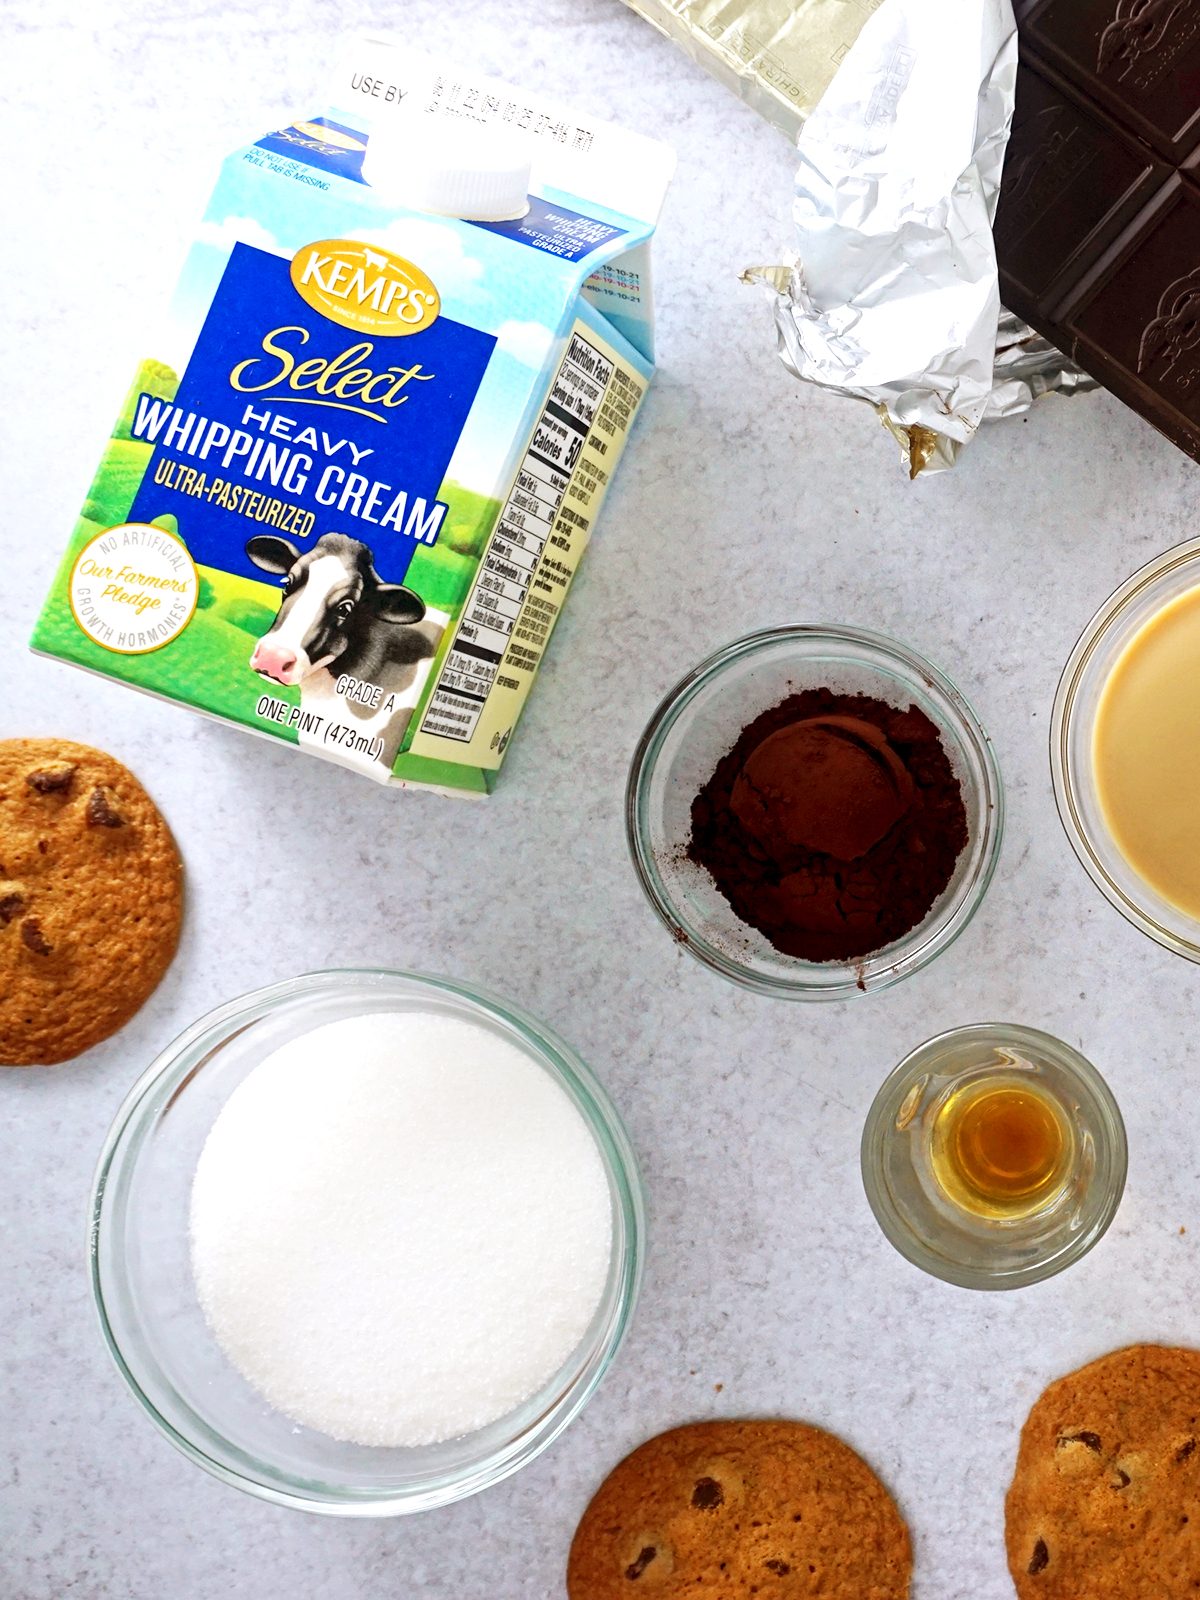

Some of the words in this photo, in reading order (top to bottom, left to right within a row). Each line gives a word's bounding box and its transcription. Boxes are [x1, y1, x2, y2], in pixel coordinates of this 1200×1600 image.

[351, 73, 384, 98] USE
[385, 86, 408, 105] BY
[243, 153, 265, 168] PULL
[267, 162, 282, 174] TAB
[283, 168, 292, 177] IS
[293, 172, 330, 191] MISSING
[266, 153, 282, 163] NOT
[518, 227, 581, 253] PASTEURIZED
[544, 213, 609, 239] WHIPPING
[552, 224, 598, 244] CREAM
[554, 233, 587, 248] ULTRA-
[575, 218, 618, 234] HEAVY
[532, 240, 565, 256] GRADE
[564, 250, 574, 259] A
[300, 250, 425, 324] KEMPS
[229, 326, 435, 408] Select
[568, 338, 596, 374] Nutrition
[592, 358, 610, 386] Facts
[241, 404, 374, 466] HEAVY
[532, 428, 562, 460] Calories
[564, 436, 582, 469] 50
[133, 396, 313, 496] WHIPPING
[316, 465, 447, 546] CREAM
[154, 457, 316, 538] ULTRA-PASTEURIZED
[79, 559, 114, 579] Our
[99, 537, 118, 555] NO
[123, 531, 186, 573] ARTIFICIAL
[77, 588, 114, 642] GROWTH
[100, 583, 161, 616] Pledge
[336, 675, 382, 707] GRADE
[383, 694, 395, 712] A
[257, 696, 288, 723] ONE
[288, 708, 324, 735] PINT
[323, 721, 383, 761] (473mL)
